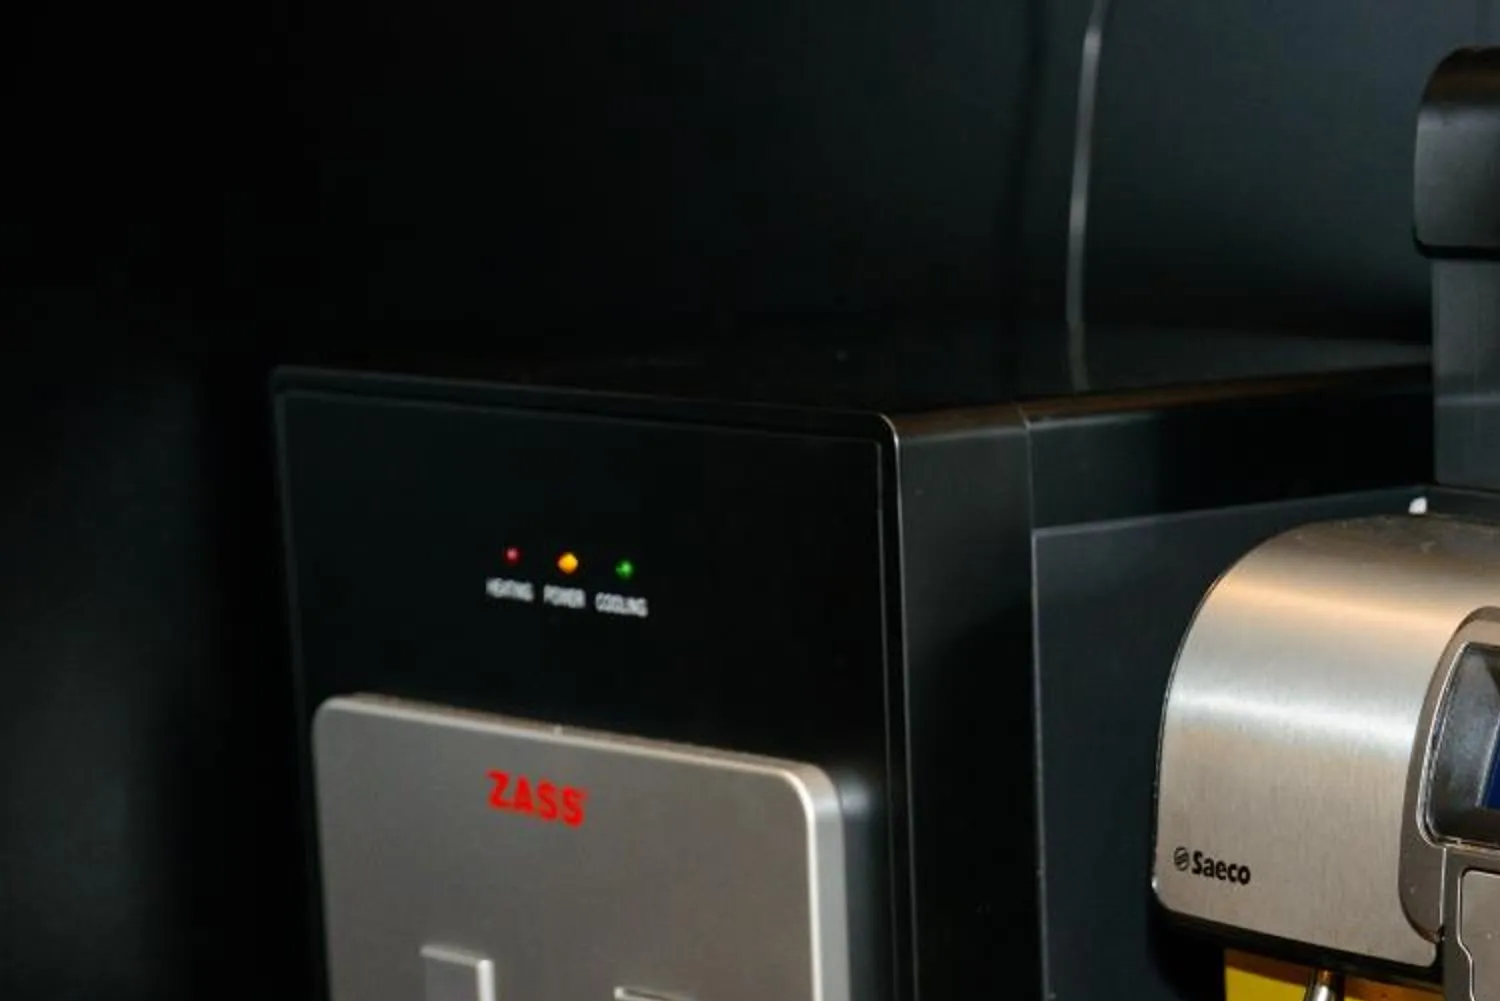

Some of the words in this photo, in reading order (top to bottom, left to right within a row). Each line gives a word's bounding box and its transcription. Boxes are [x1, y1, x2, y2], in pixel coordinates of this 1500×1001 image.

[544, 585, 585, 608] POWER
[596, 592, 648, 618] COOLING
[486, 769, 586, 829] ZASS
[1192, 850, 1251, 886] Saeco
